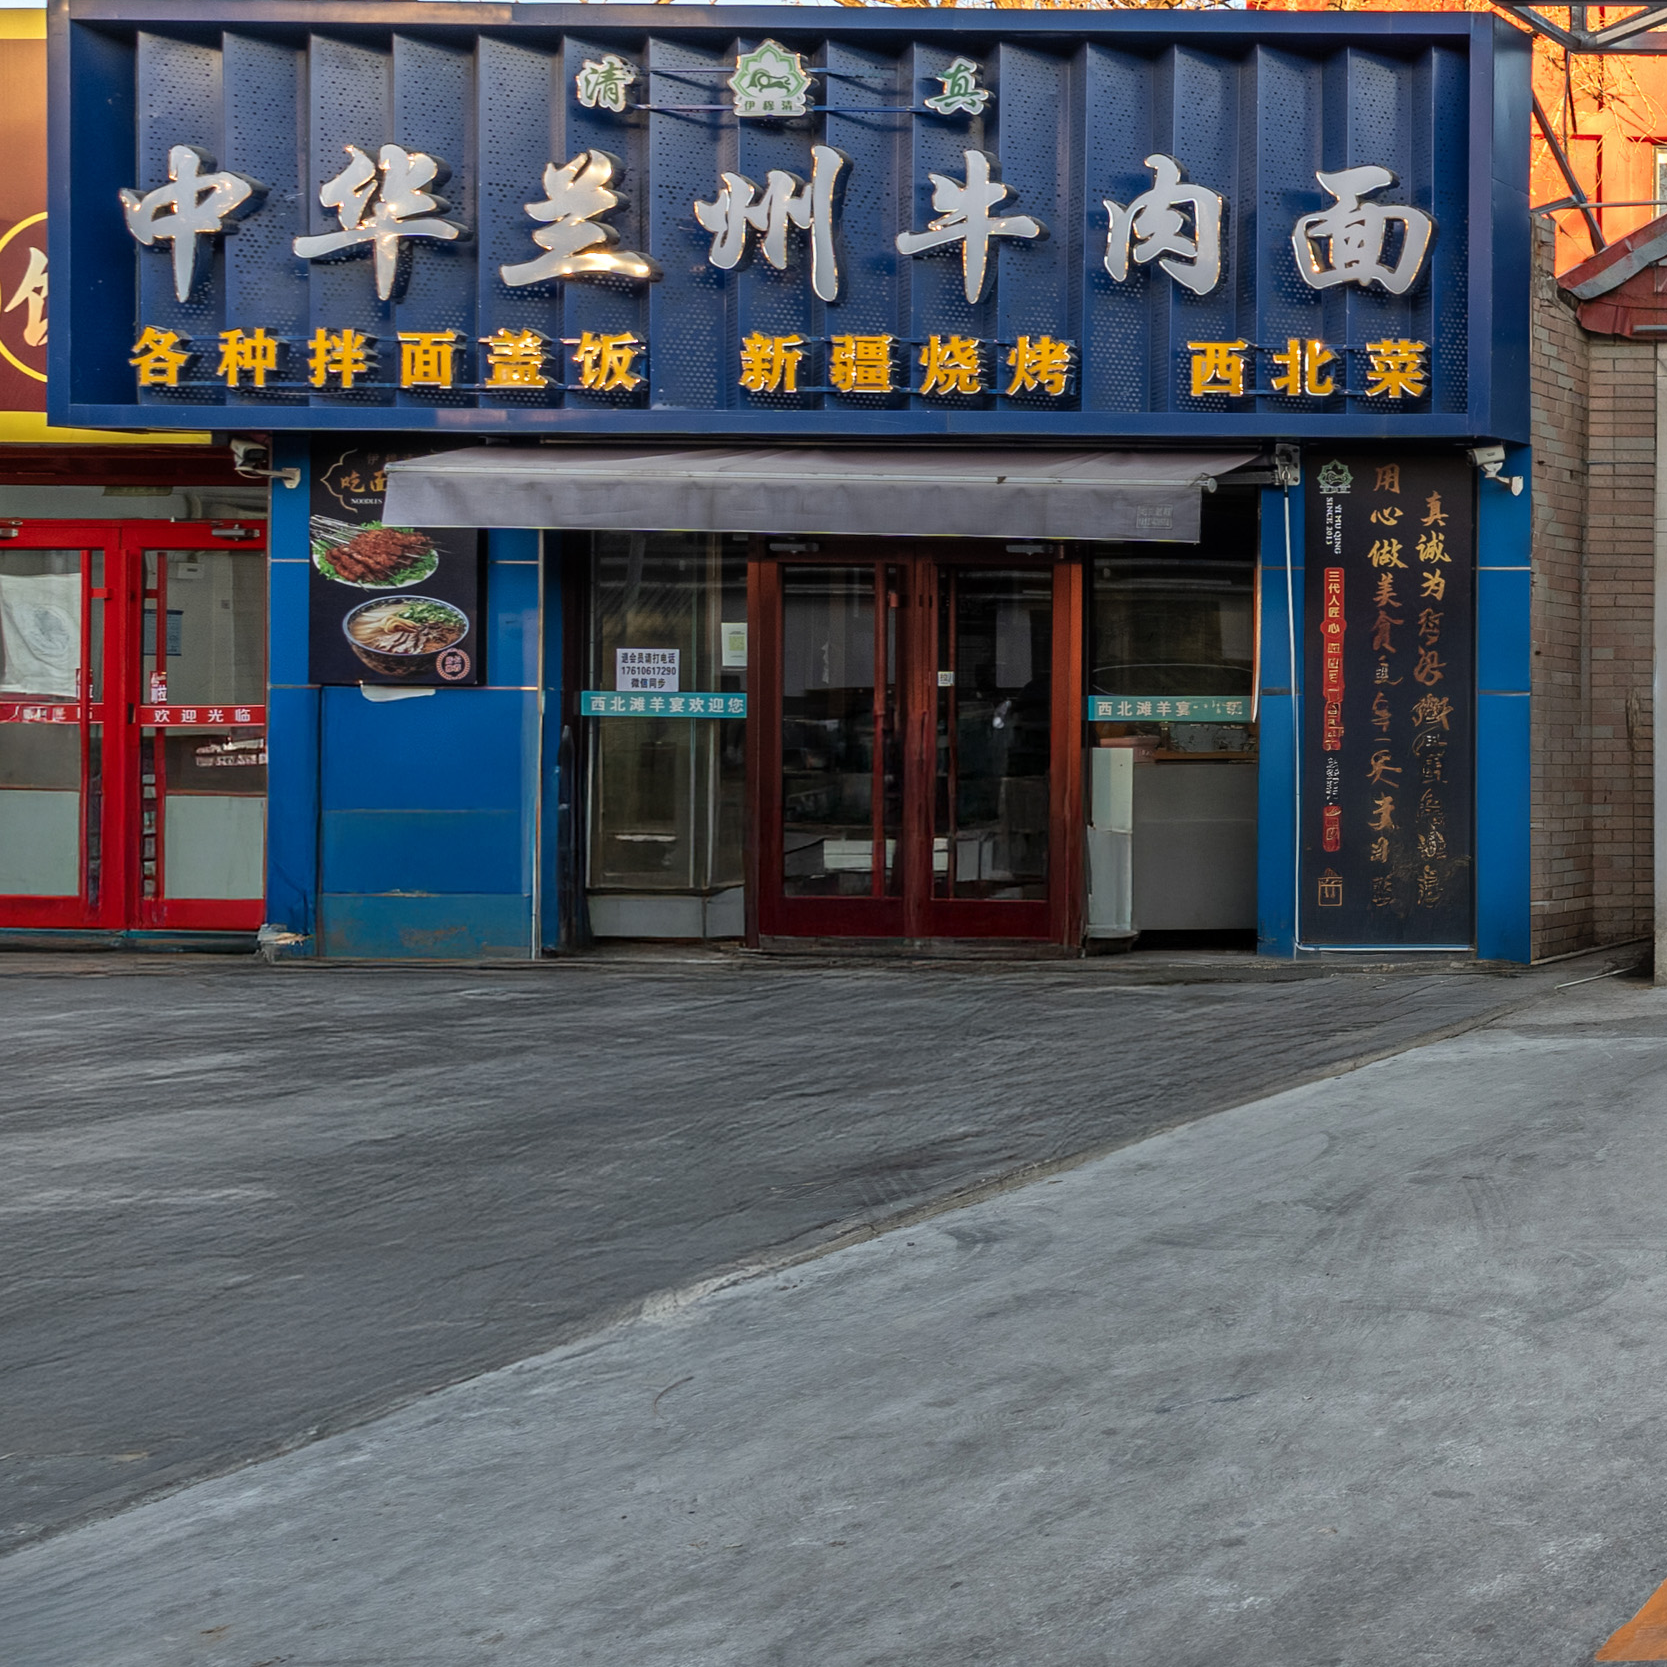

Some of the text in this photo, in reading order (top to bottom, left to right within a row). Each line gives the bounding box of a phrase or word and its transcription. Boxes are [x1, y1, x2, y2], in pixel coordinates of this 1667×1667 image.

[582, 58, 988, 112] 清 真
[119, 143, 1437, 303] 中华兰州牛肉面
[129, 326, 1430, 399] 各种拌面盖饭 新疆烧烤 西北菜
[621, 652, 676, 665] 退会员请打电话
[621, 666, 677, 676] 17610617290
[631, 677, 666, 689] 微信同步
[590, 696, 745, 714] 西北滩羊宴欢迎您
[153, 709, 251, 723] 欢迎光临
